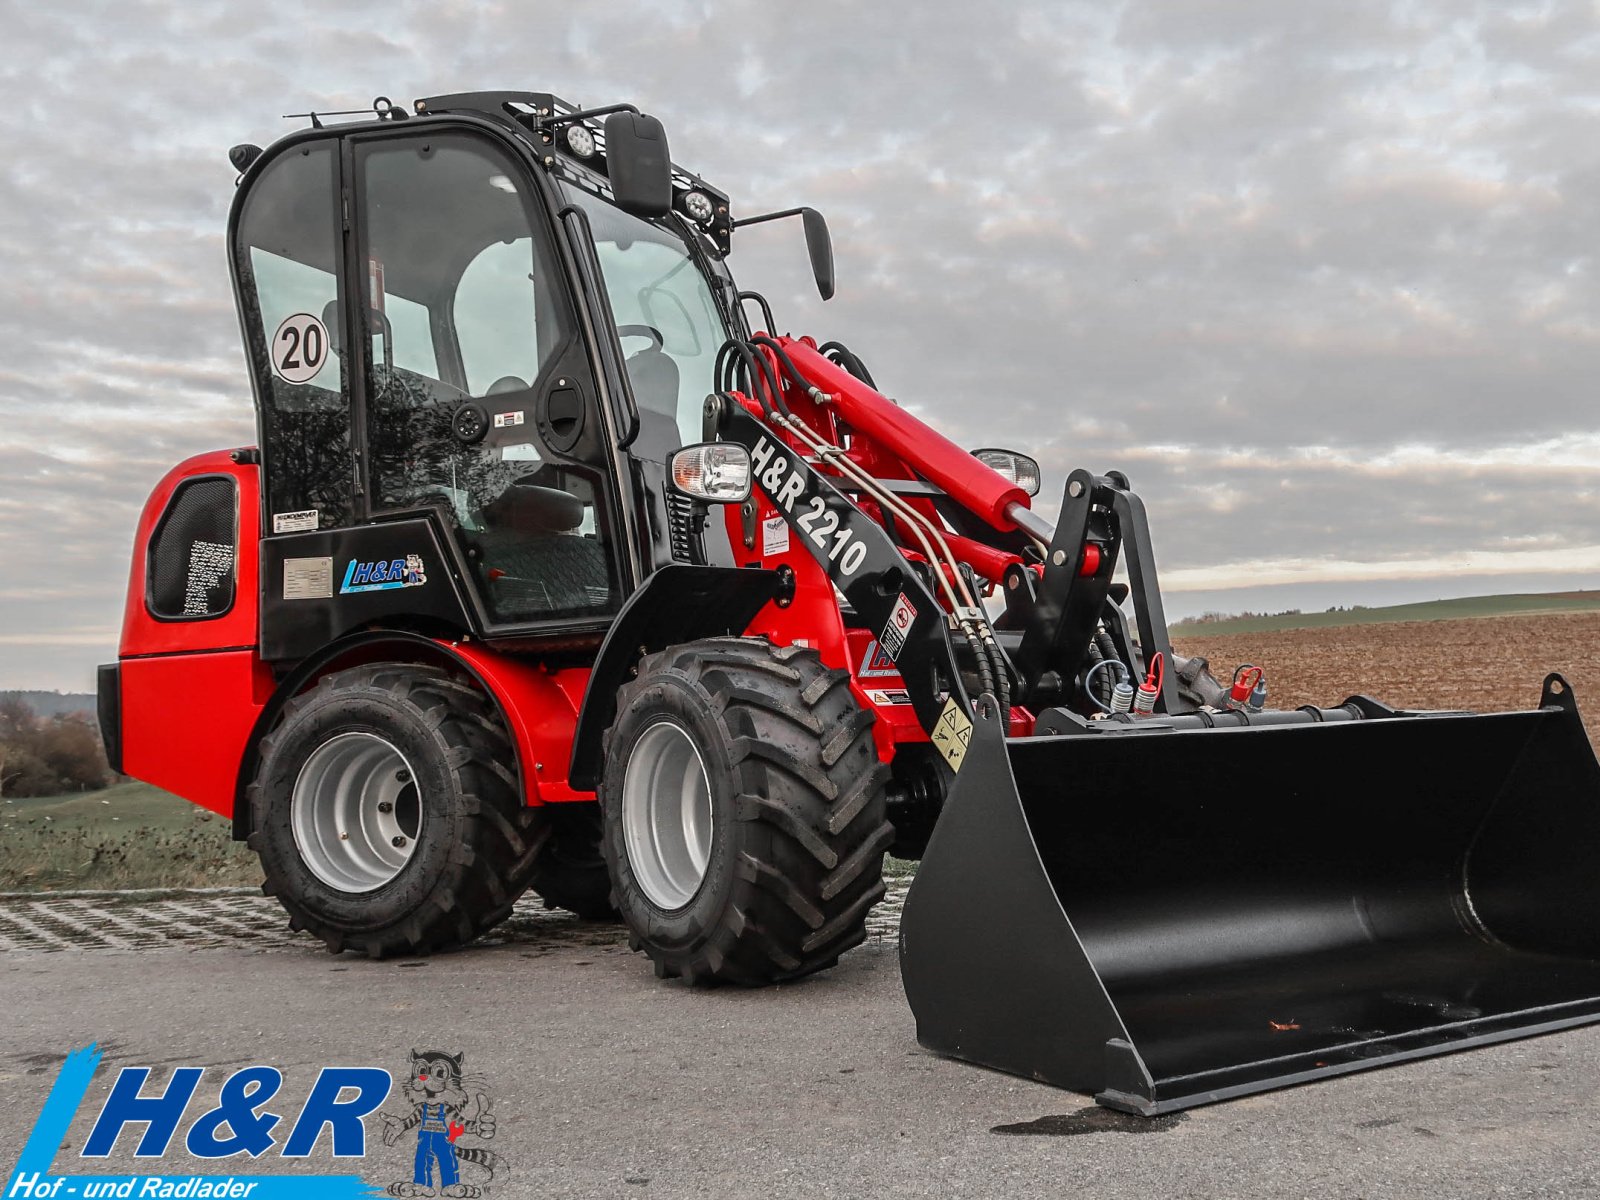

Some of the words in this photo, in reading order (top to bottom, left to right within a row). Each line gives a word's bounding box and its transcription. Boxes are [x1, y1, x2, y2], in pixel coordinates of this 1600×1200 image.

[281, 324, 322, 370] 20
[750, 435, 806, 514] H&R
[796, 496, 867, 576] 2210
[352, 559, 406, 584] H&R
